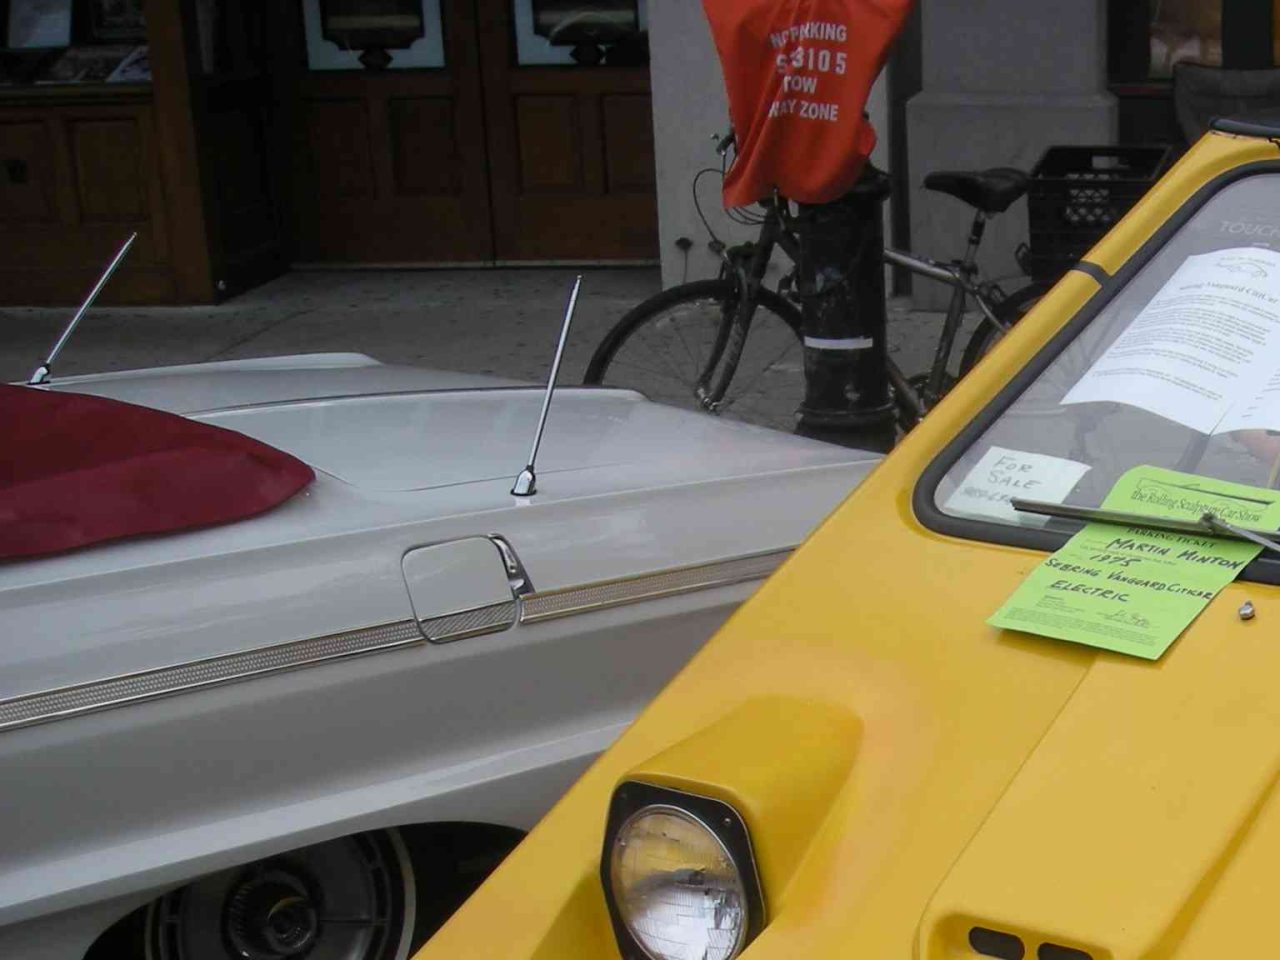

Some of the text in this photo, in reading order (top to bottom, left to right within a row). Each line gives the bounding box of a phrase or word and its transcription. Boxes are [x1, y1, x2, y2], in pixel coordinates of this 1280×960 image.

[800, 101, 839, 121] ZONE
[994, 455, 1033, 473] FOR
[987, 469, 1041, 489] SALE
[1105, 538, 1171, 556] MARTIN
[1090, 553, 1141, 567] 1975
[1049, 580, 1130, 602] ELECTRIC
